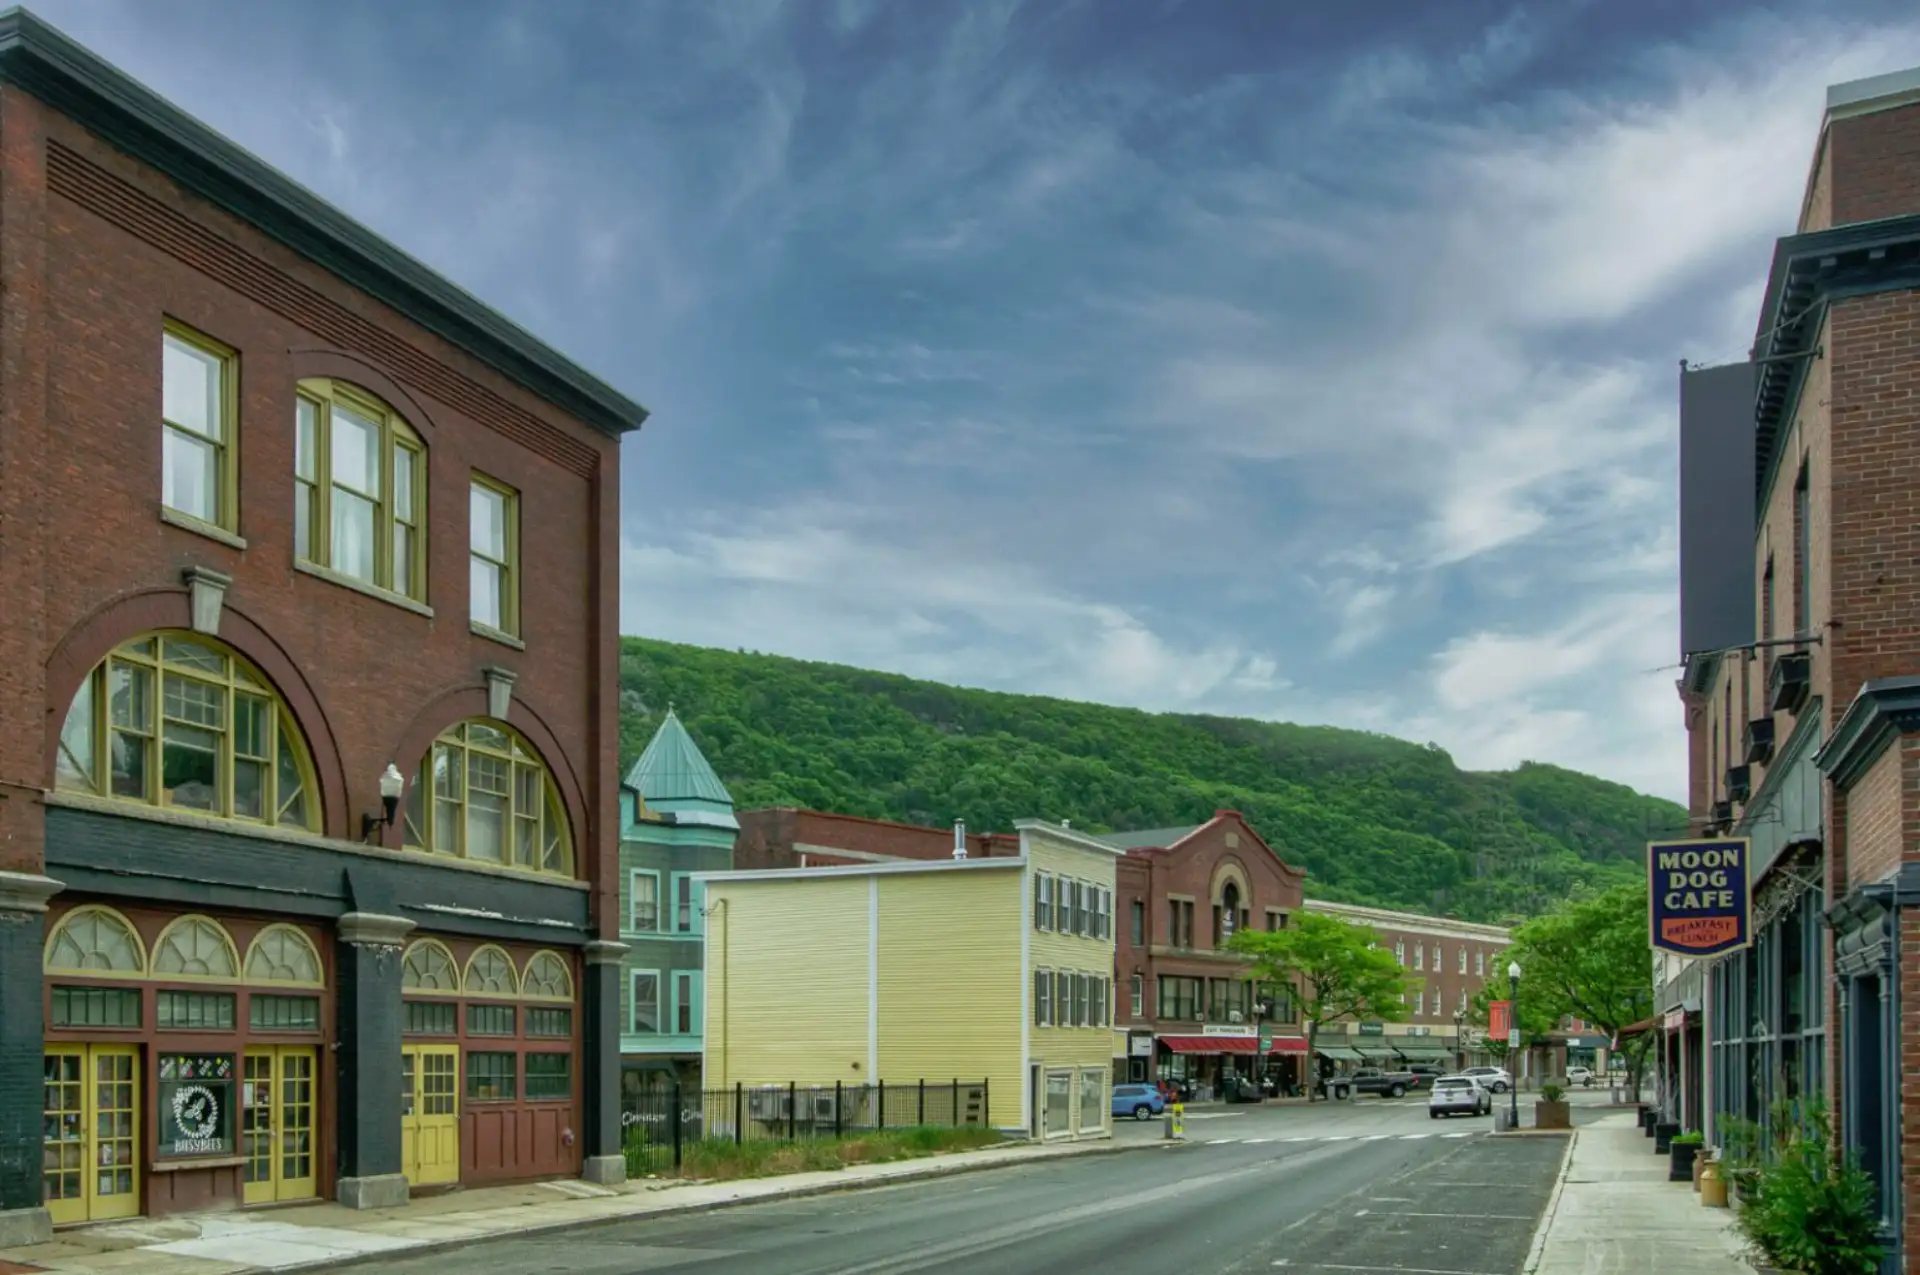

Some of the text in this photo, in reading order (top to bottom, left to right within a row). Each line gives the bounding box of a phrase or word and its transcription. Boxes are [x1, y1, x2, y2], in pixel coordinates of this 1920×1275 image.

[1659, 849, 1739, 870] MOON
[1669, 870, 1728, 889] DOG
[1664, 891, 1734, 909] CAFE
[1667, 920, 1731, 936] BREAKFAST
[1681, 933, 1718, 942] LUNCH
